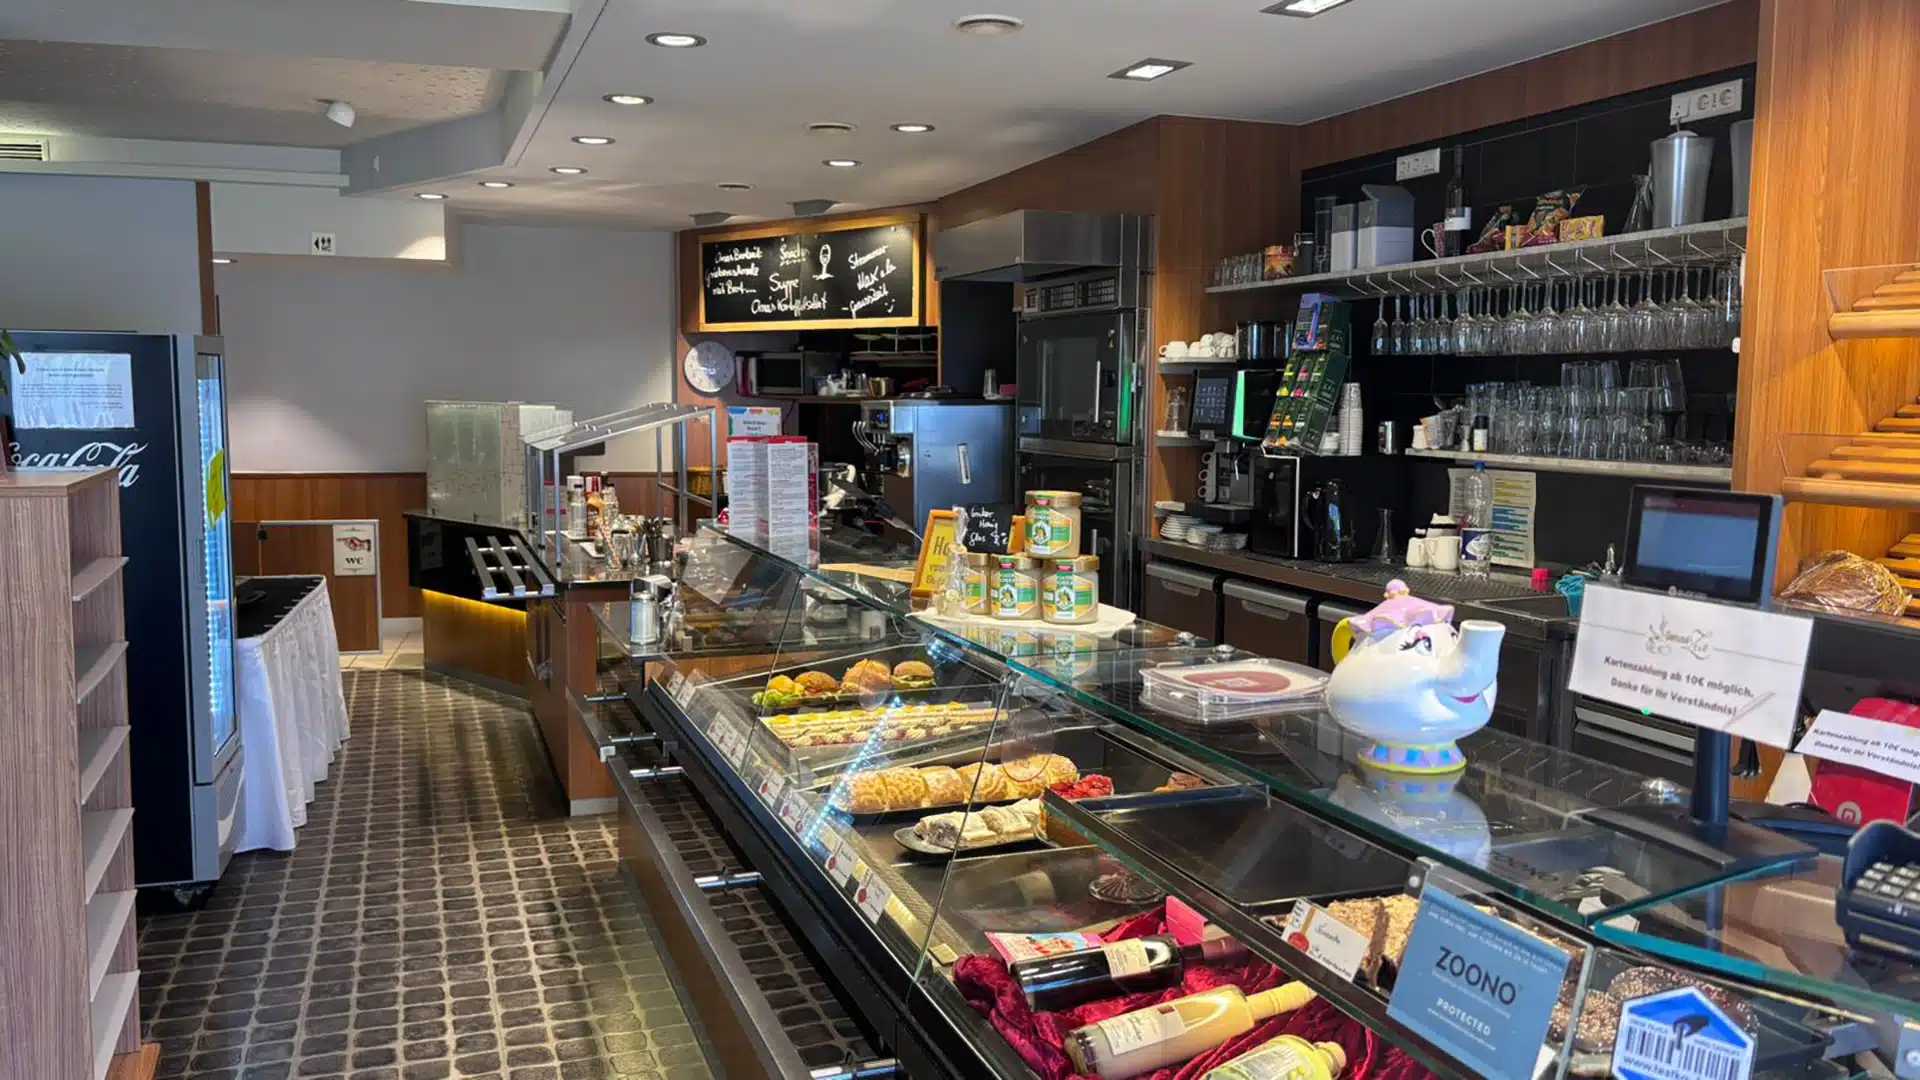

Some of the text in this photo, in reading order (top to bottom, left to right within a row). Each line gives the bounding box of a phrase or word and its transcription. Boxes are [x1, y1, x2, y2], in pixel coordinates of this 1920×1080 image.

[768, 272, 799, 302] Suppe
[345, 556, 364, 565] WC
[1603, 655, 1755, 699] Kartenzahlung ab 10€ möglich.
[1610, 676, 1738, 717] Danke für Ihr Verständnis!
[1813, 728, 1869, 746] Kartenzahlung
[1883, 741, 1900, 751] 10€
[1814, 740, 1840, 751] Danke
[1435, 945, 1517, 1006] ZOONO
[1435, 997, 1493, 1037] PROTECTED
